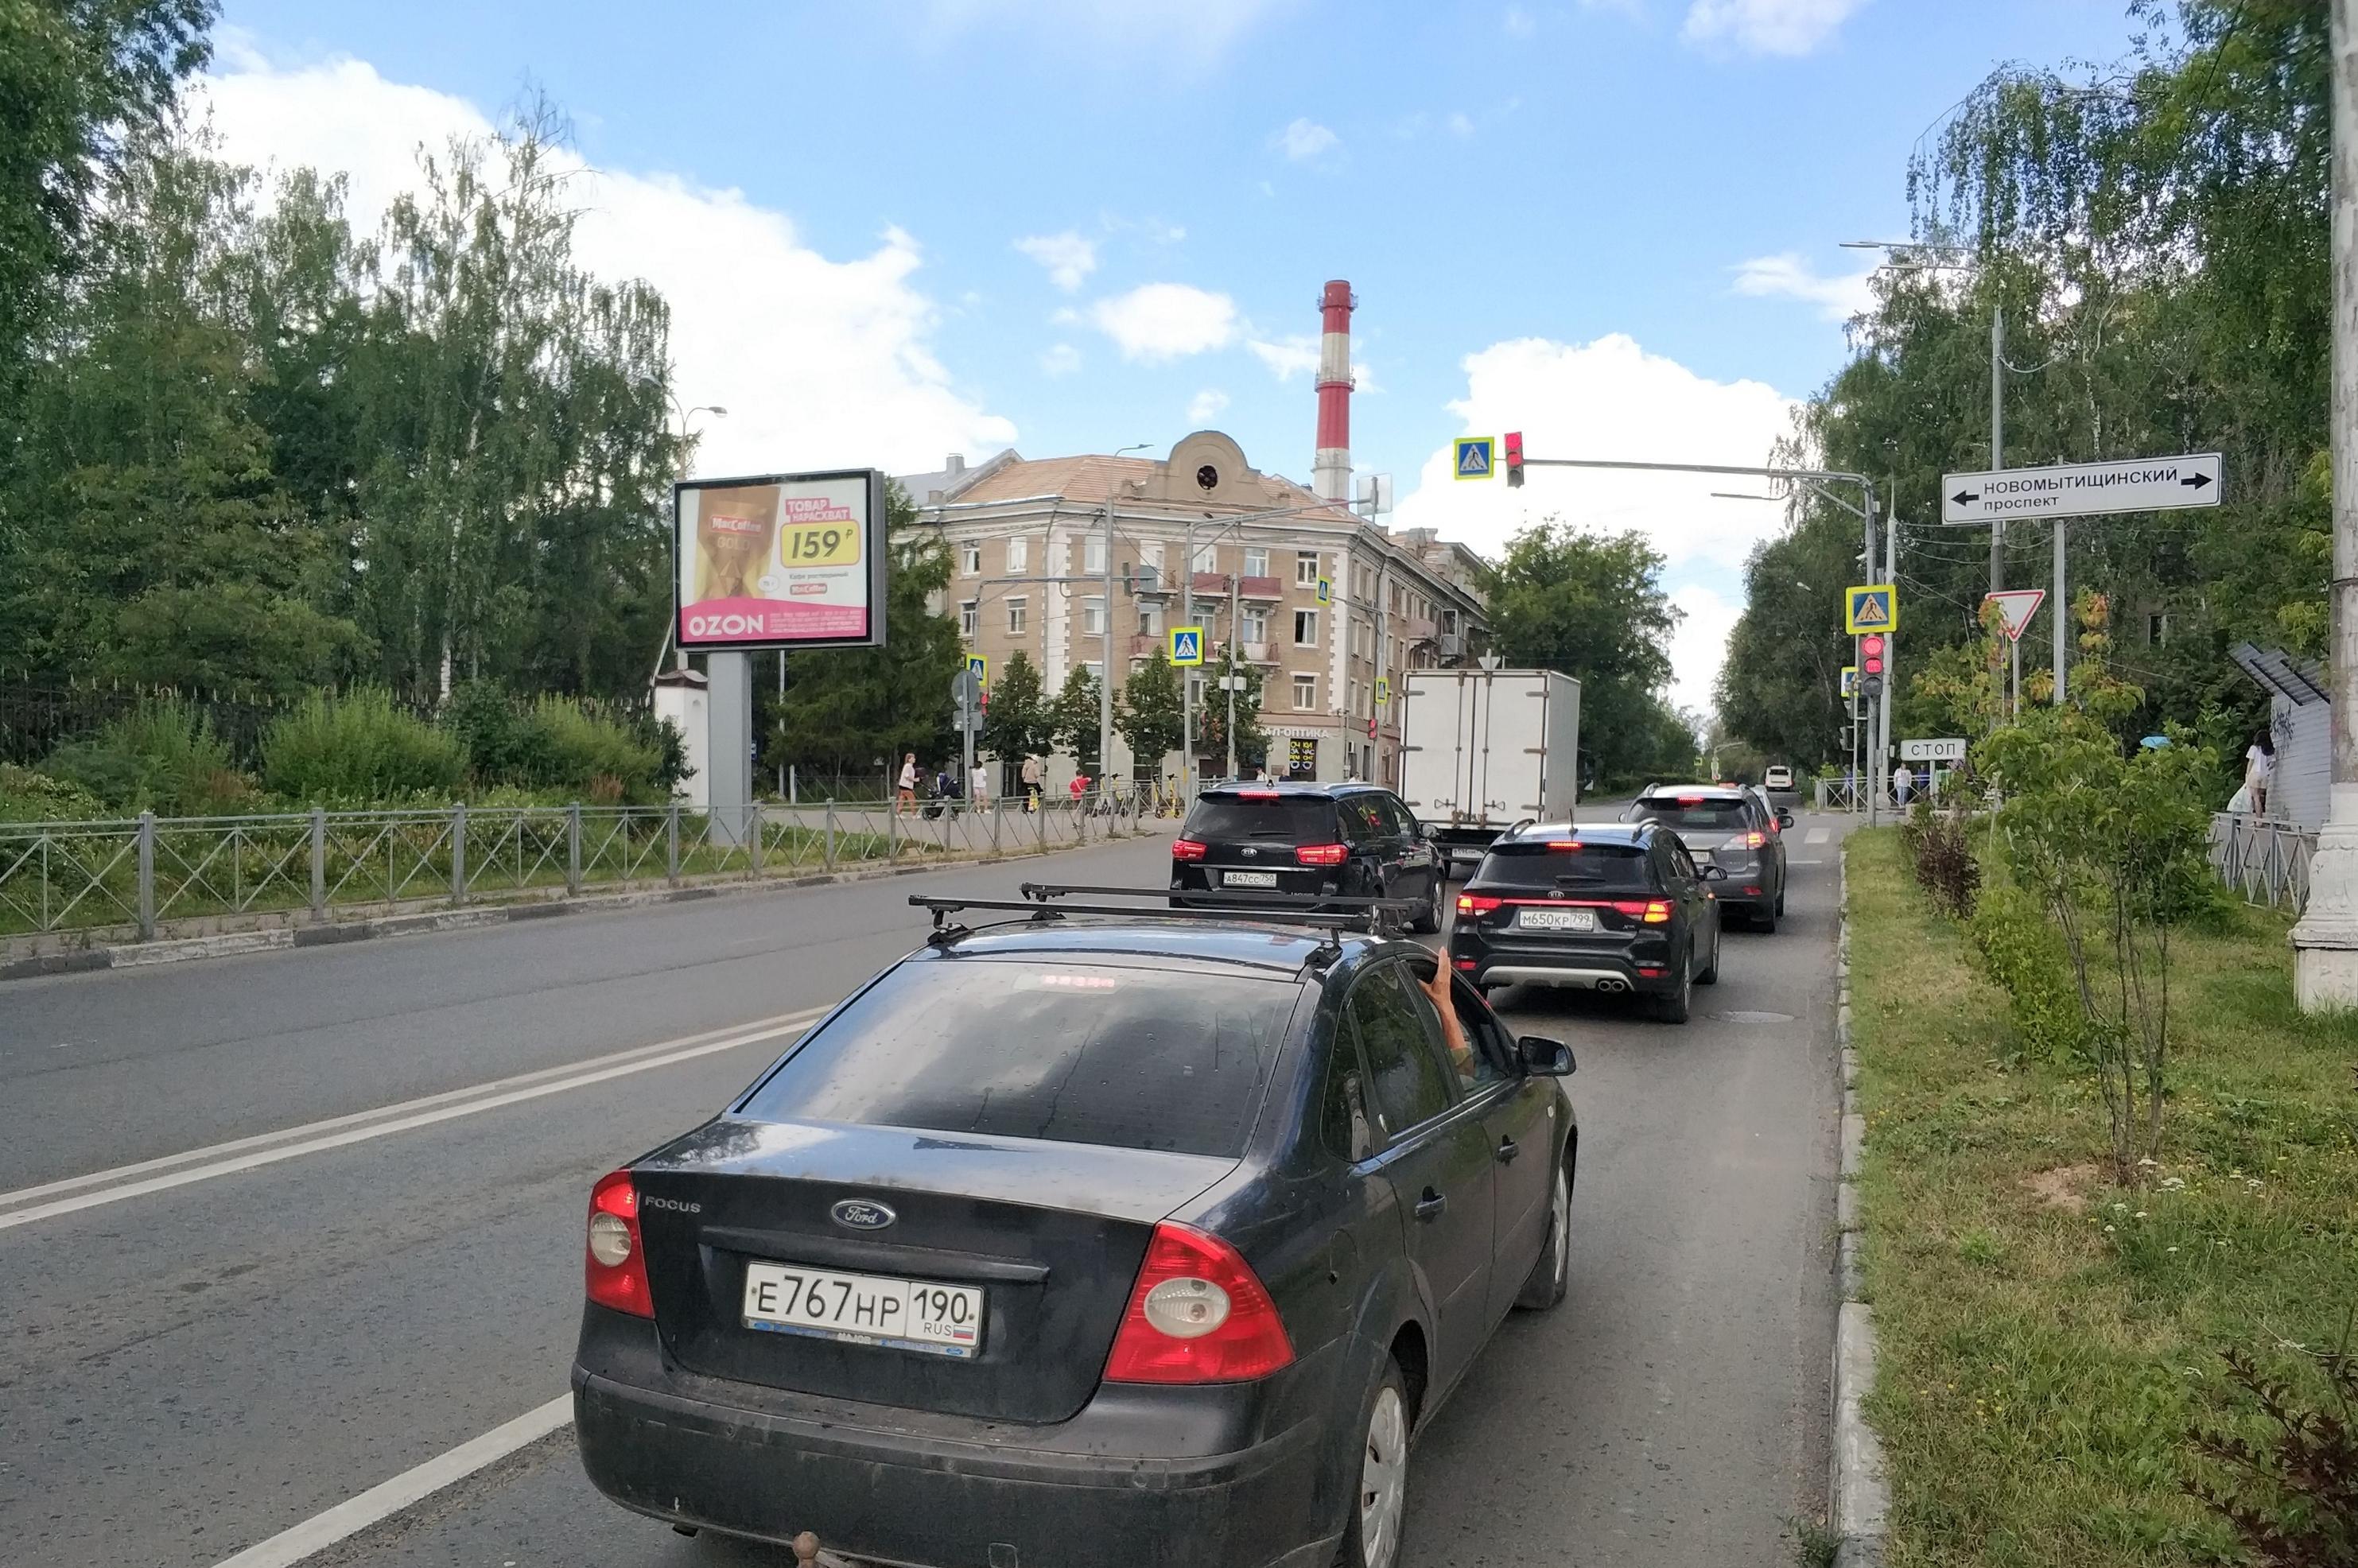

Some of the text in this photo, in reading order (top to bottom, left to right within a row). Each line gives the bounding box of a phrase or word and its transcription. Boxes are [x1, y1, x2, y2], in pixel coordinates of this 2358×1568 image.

[1984, 466, 2177, 495] НОВОМЫТИЩИНСКИЙ
[787, 499, 828, 513] ТОВАР
[1984, 496, 2060, 513] проспект
[792, 530, 841, 559] 159
[689, 614, 763, 636] OZON
[1911, 743, 1956, 755] СТОП
[1571, 914, 1590, 923] 799
[644, 1195, 701, 1213] FOCUS
[844, 1205, 879, 1225] Ford
[757, 1275, 969, 1328] Е767НР 190
[923, 1322, 953, 1337] RUS
